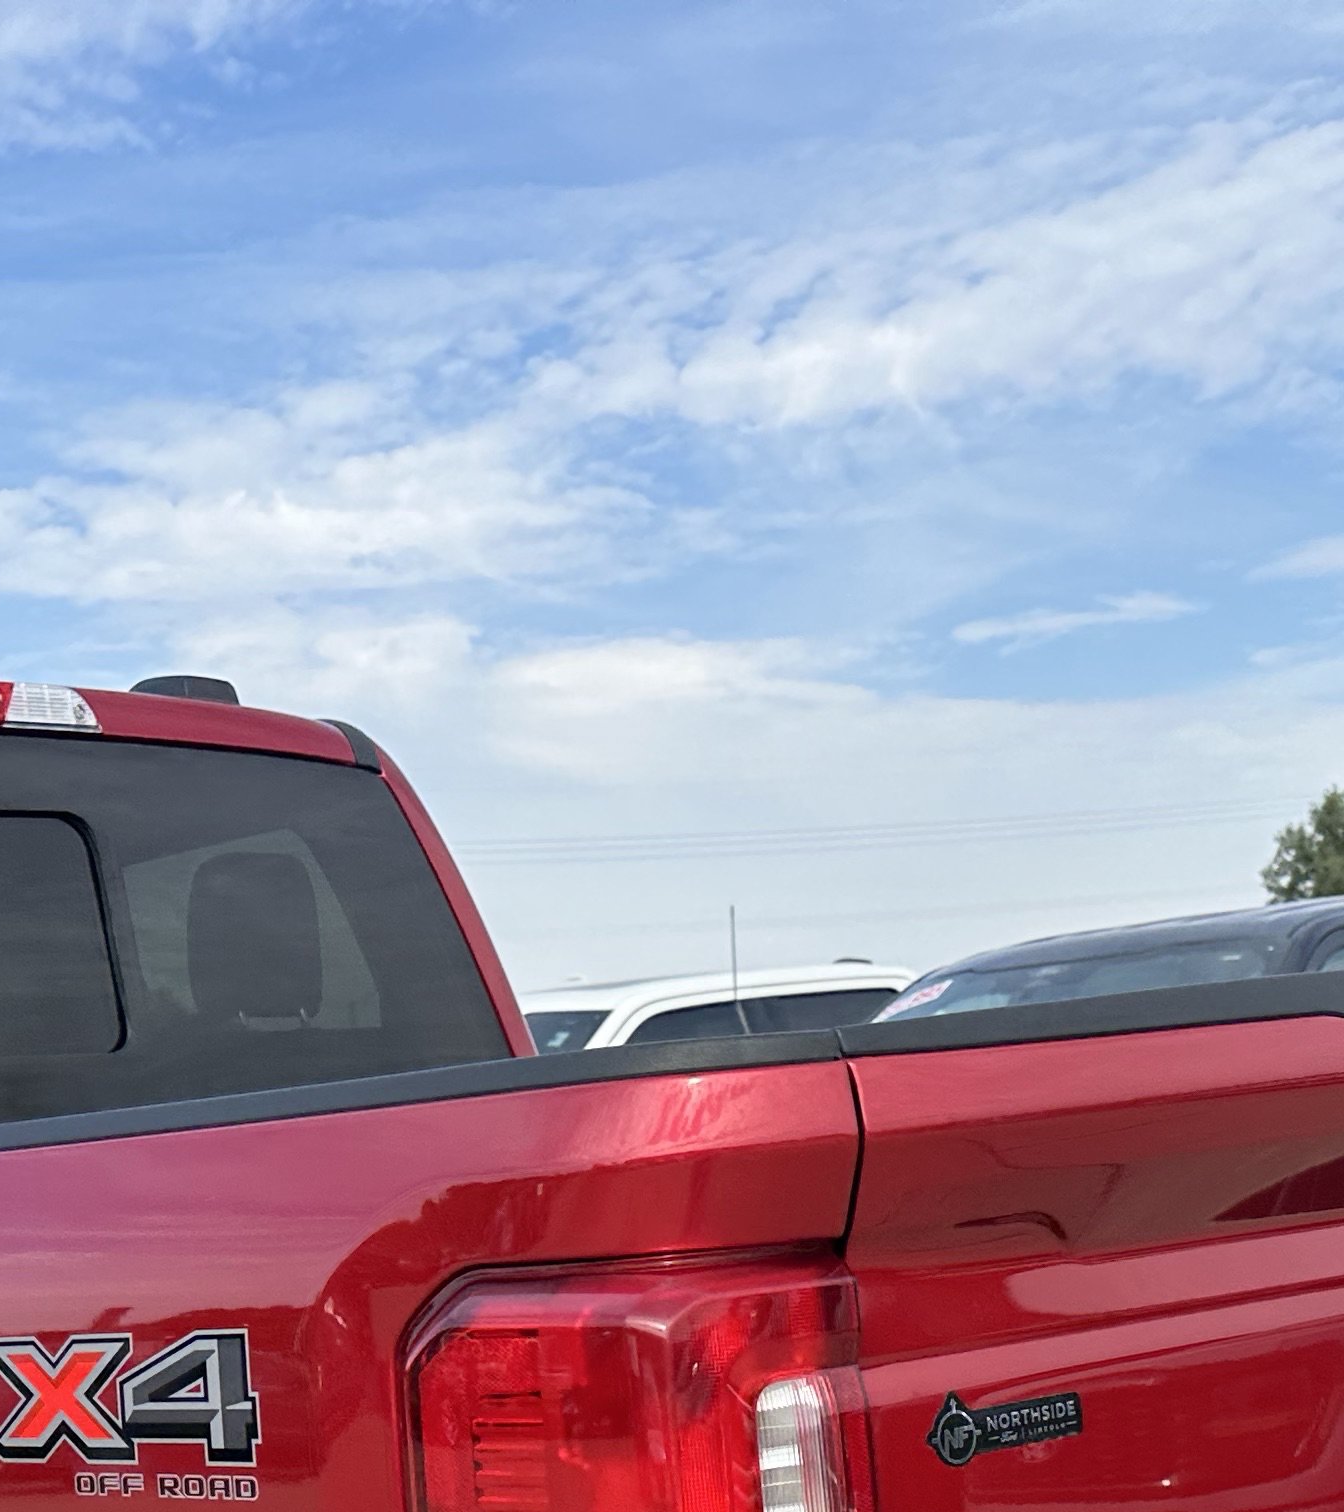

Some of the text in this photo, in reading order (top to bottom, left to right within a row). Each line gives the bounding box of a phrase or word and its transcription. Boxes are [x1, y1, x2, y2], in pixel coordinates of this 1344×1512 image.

[986, 1399, 1077, 1432] NORTHSIDE
[75, 1471, 260, 1501] OFF ROAD
